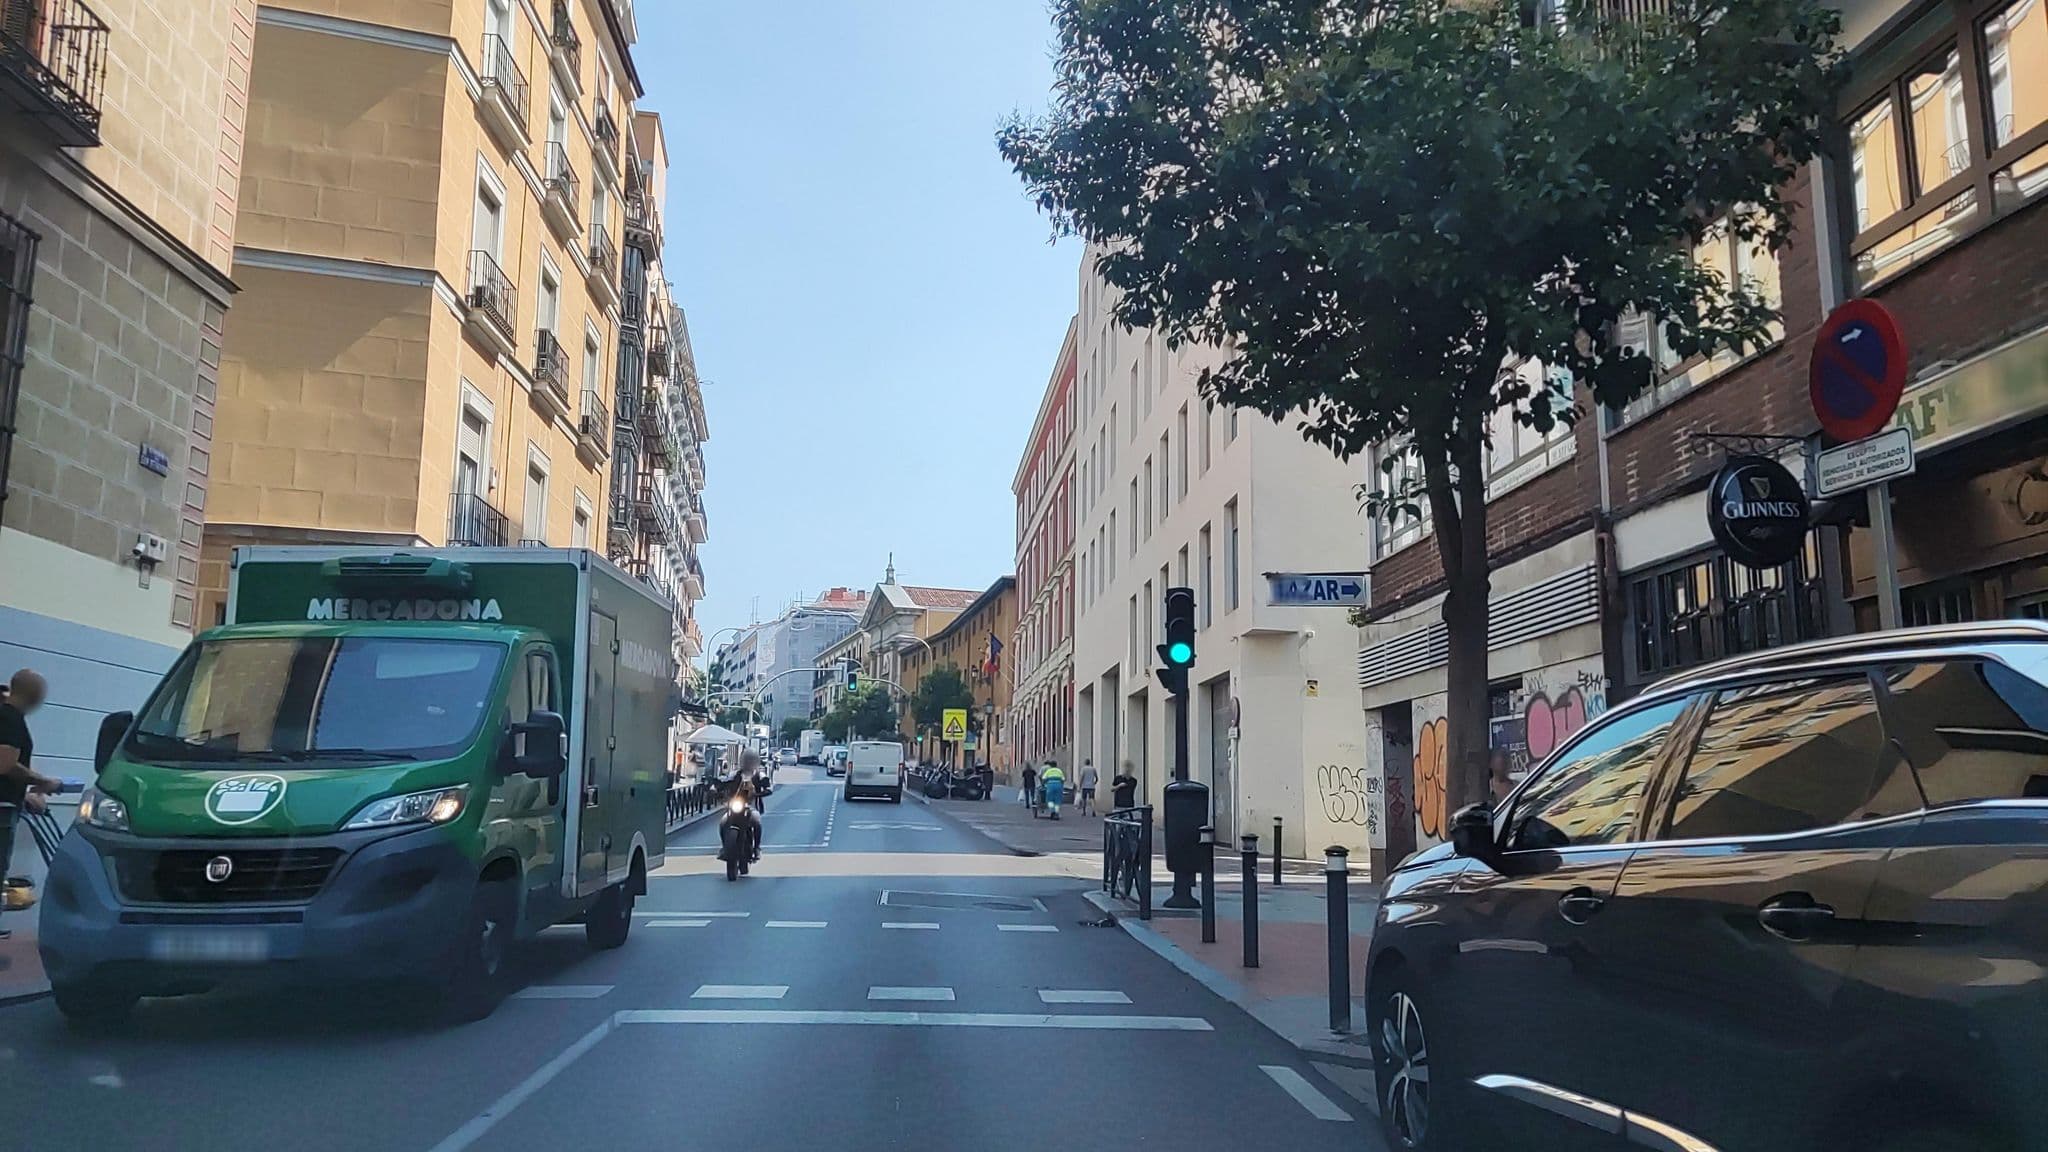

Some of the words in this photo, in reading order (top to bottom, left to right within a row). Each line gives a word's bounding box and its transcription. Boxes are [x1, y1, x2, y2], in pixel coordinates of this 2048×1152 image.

[1859, 446, 1906, 466] AUTORIZADOS
[1856, 467, 1865, 477] DE
[1867, 457, 1904, 474] BOMBEROS
[1722, 501, 1800, 519] GUINNESS
[307, 598, 503, 620] MERCADONA
